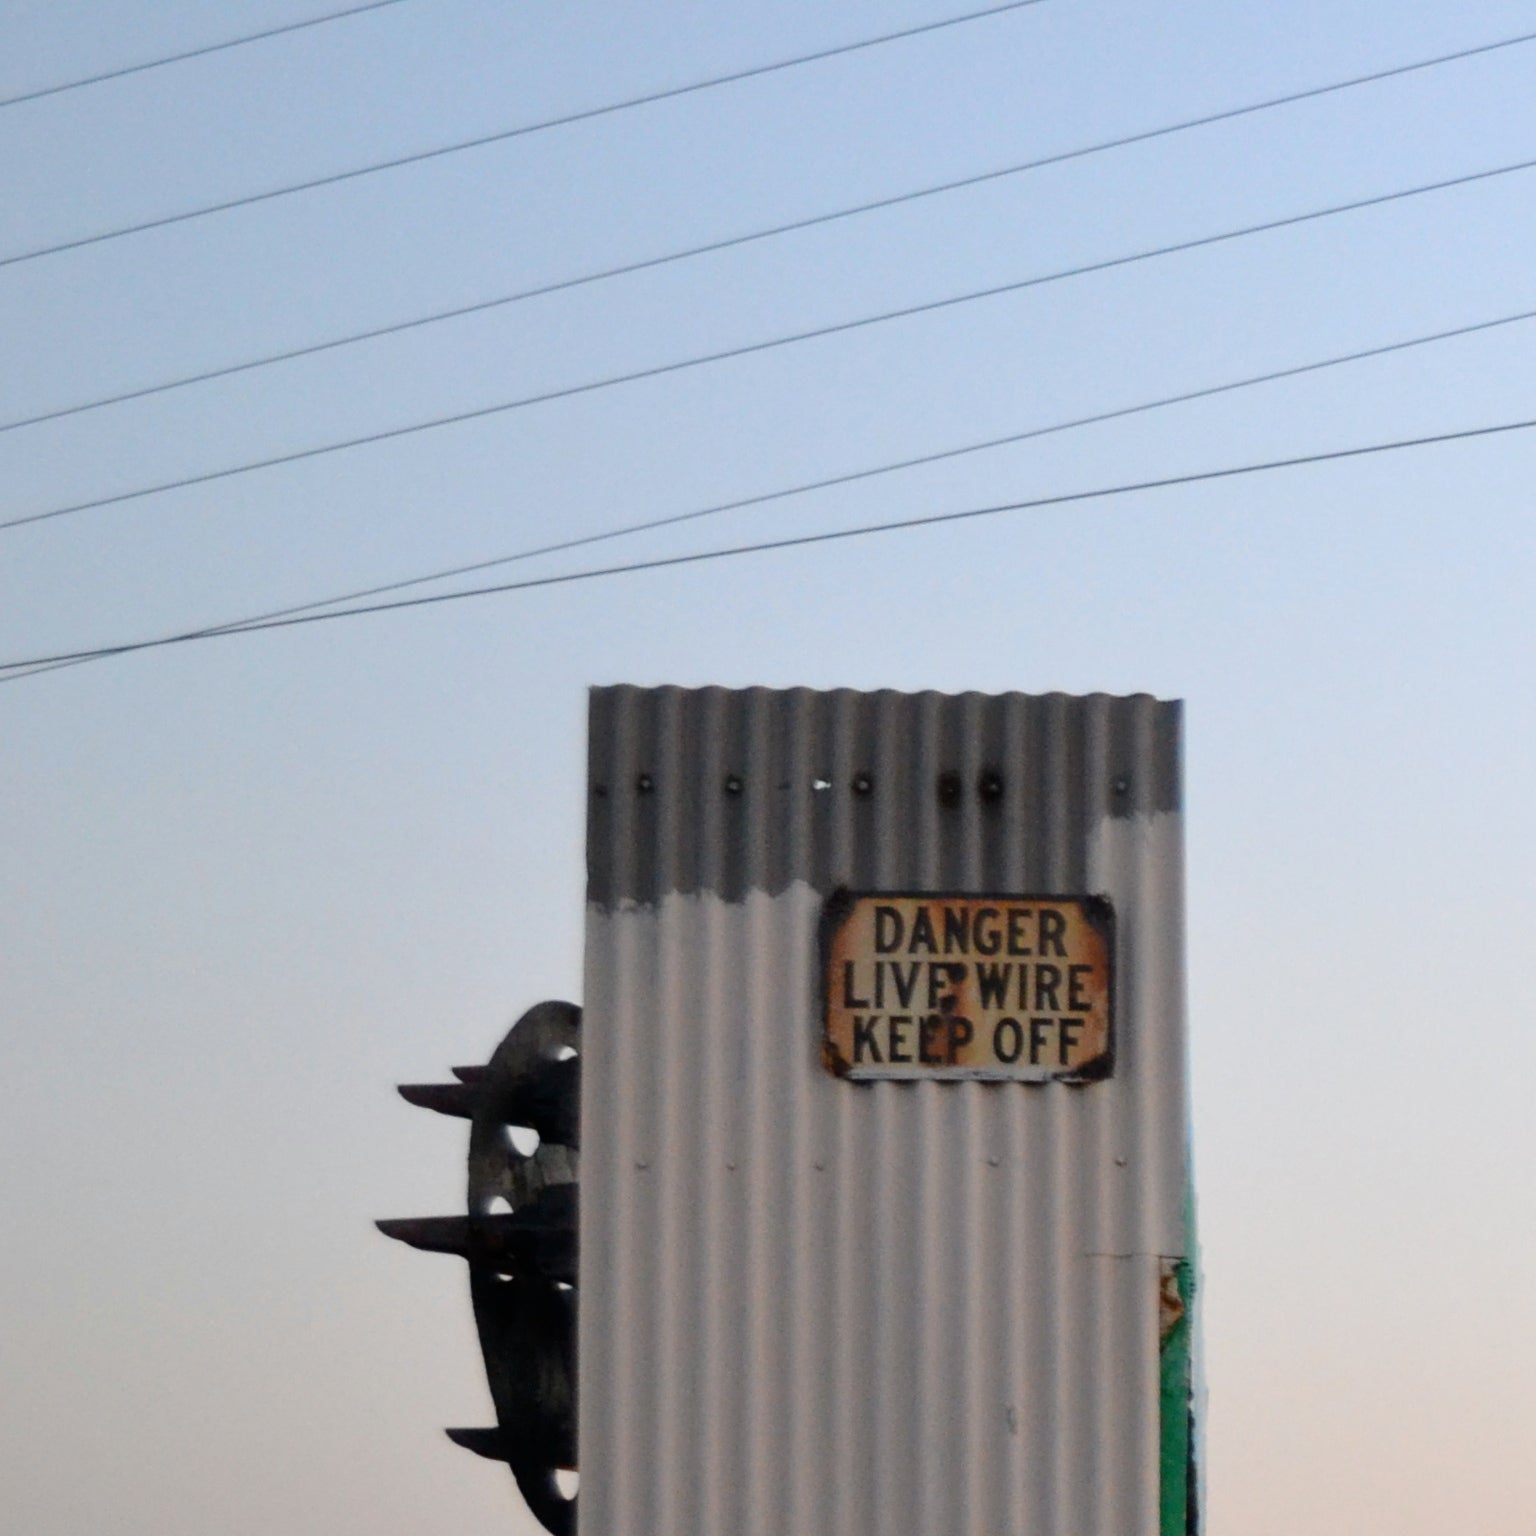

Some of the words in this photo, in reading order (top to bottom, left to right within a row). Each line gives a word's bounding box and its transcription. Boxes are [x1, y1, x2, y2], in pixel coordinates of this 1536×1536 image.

[873, 906, 1068, 957] DANGER
[843, 960, 953, 1010] LIVE
[975, 961, 1094, 1012] WIRE
[852, 1015, 975, 1064] KEEP
[992, 1016, 1086, 1066] OFF
